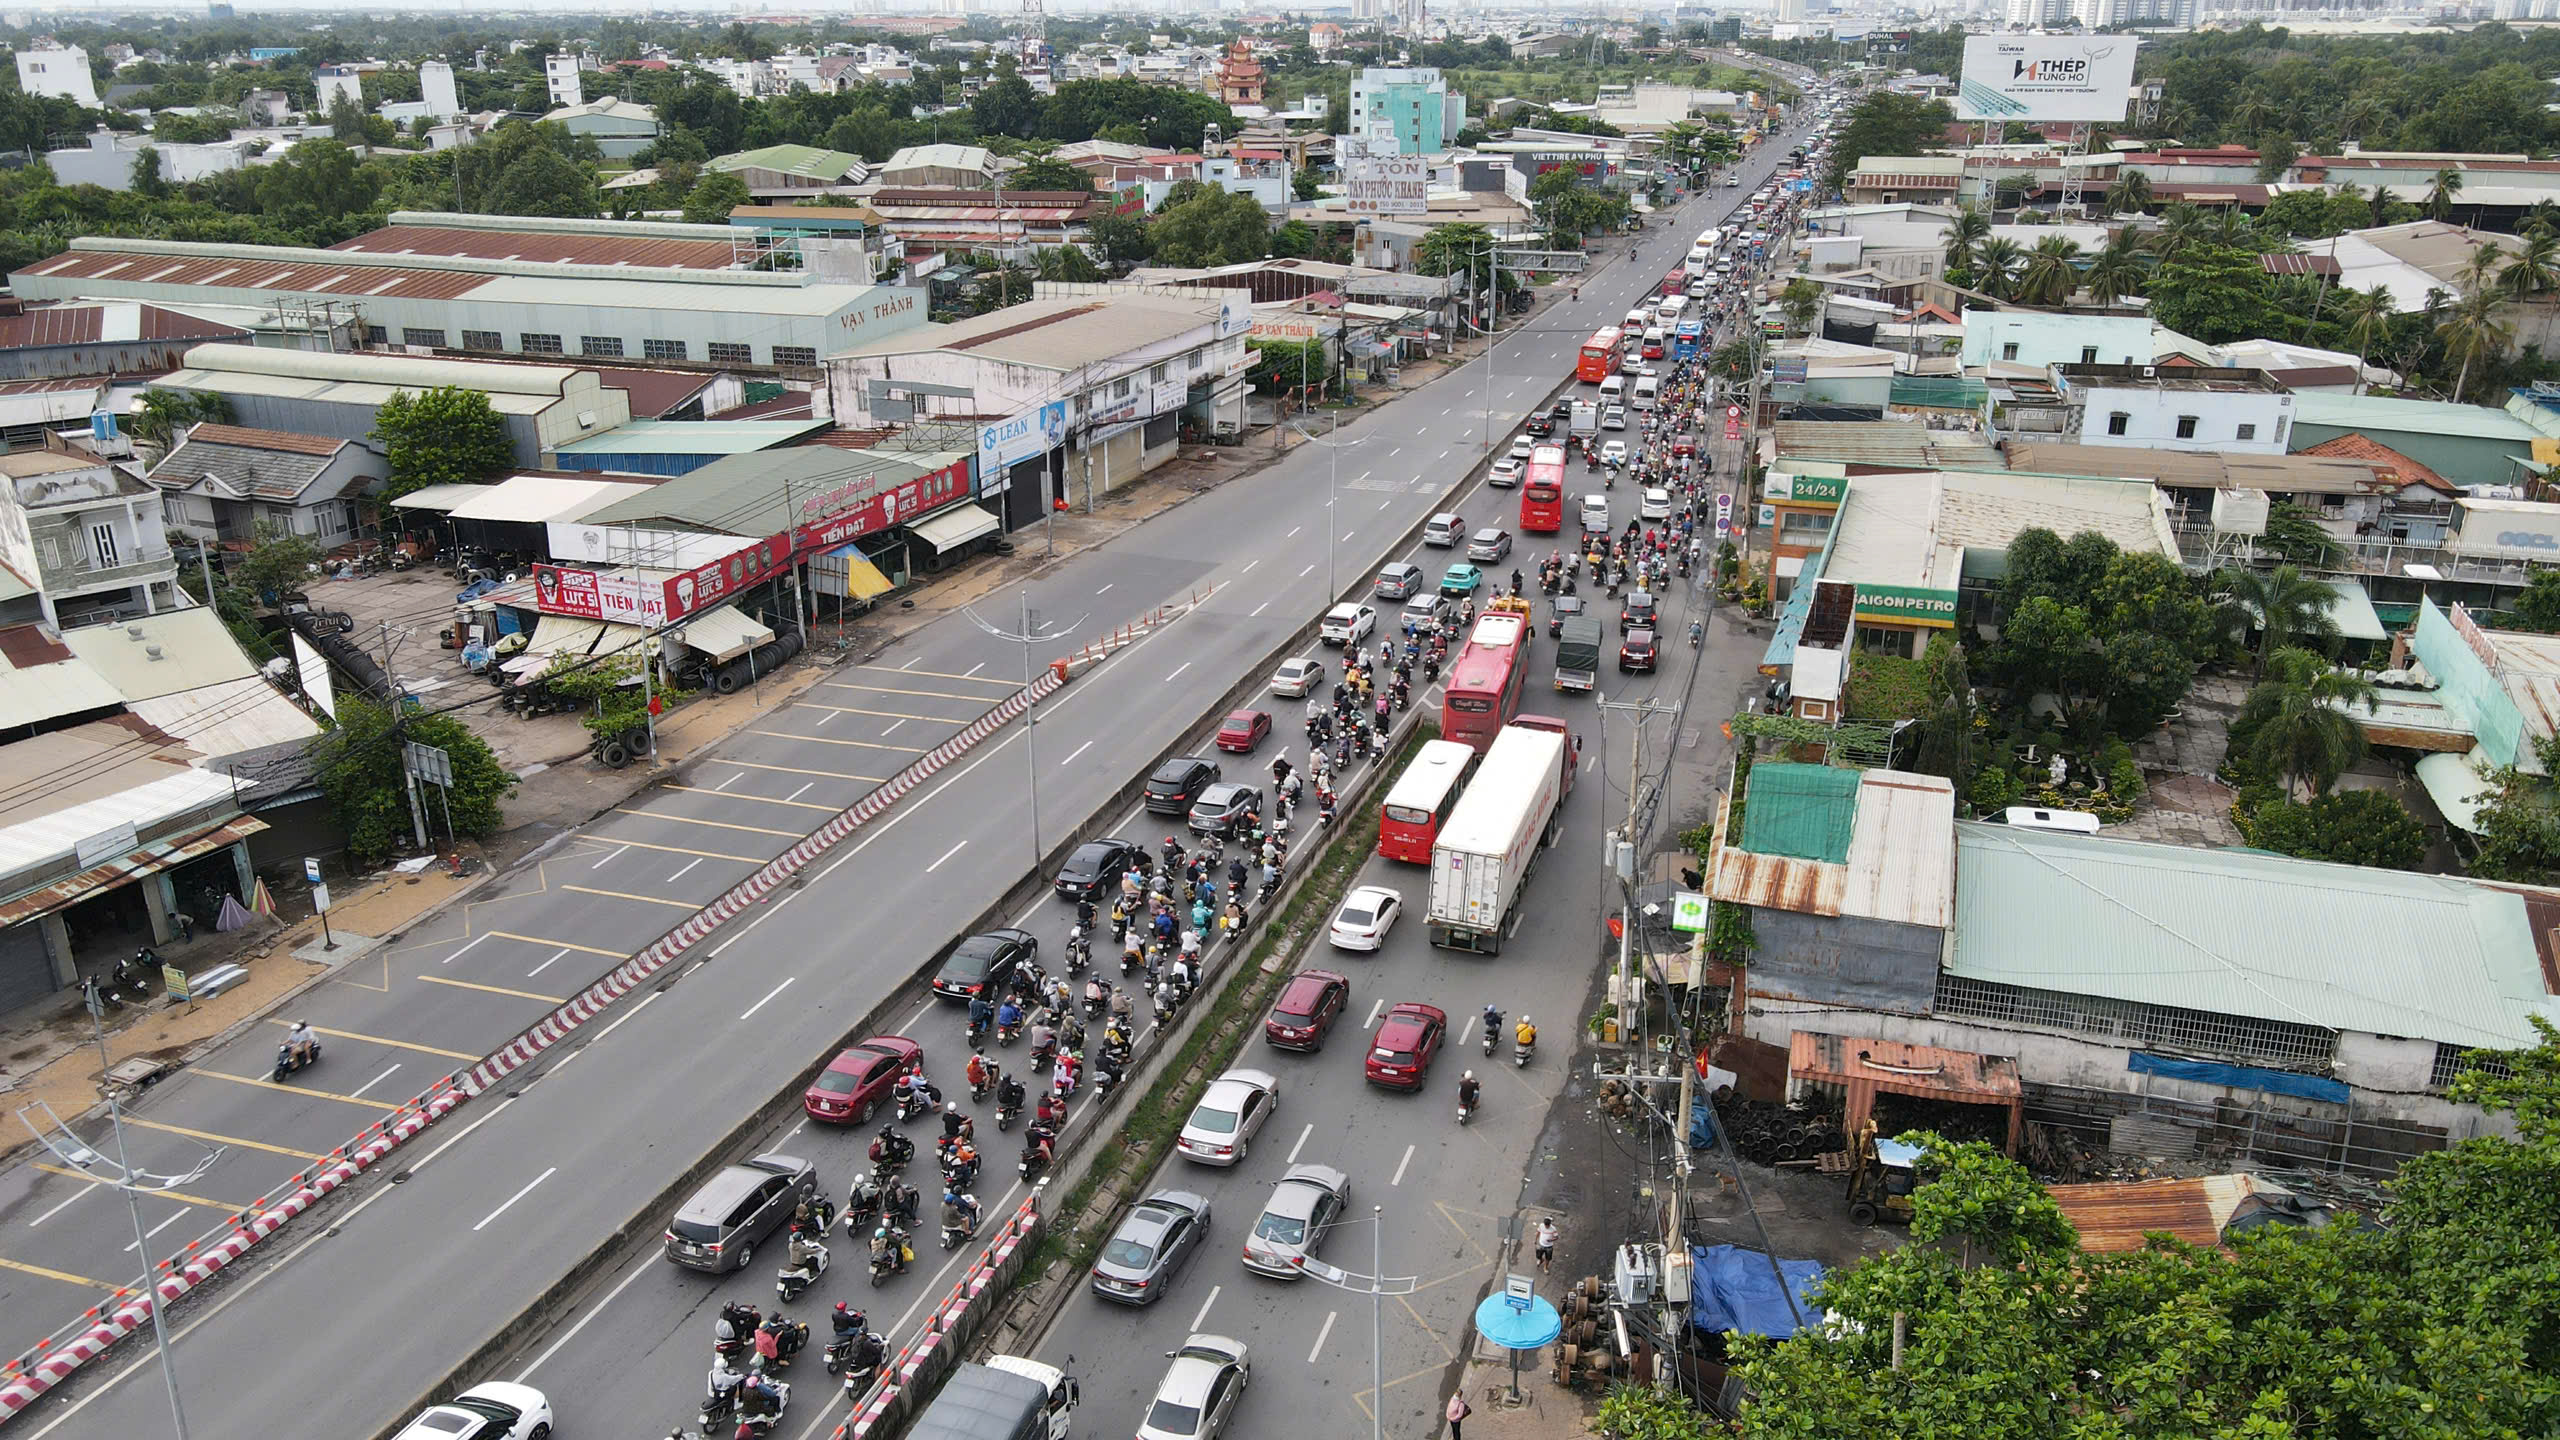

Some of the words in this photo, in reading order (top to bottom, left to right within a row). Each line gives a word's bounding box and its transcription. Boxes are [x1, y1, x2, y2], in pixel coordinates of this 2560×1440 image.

[2040, 57, 2086, 73] THÉP
[2037, 73, 2066, 82] TUNG
[2068, 73, 2085, 82] HO
[1374, 160, 1420, 174] TÔN
[1394, 181, 1424, 199] KHANH
[873, 295, 914, 319] THÀNH
[1000, 419, 1028, 441] LEAN
[1795, 481, 1837, 498] 24/24
[603, 590, 634, 612] TIẾN
